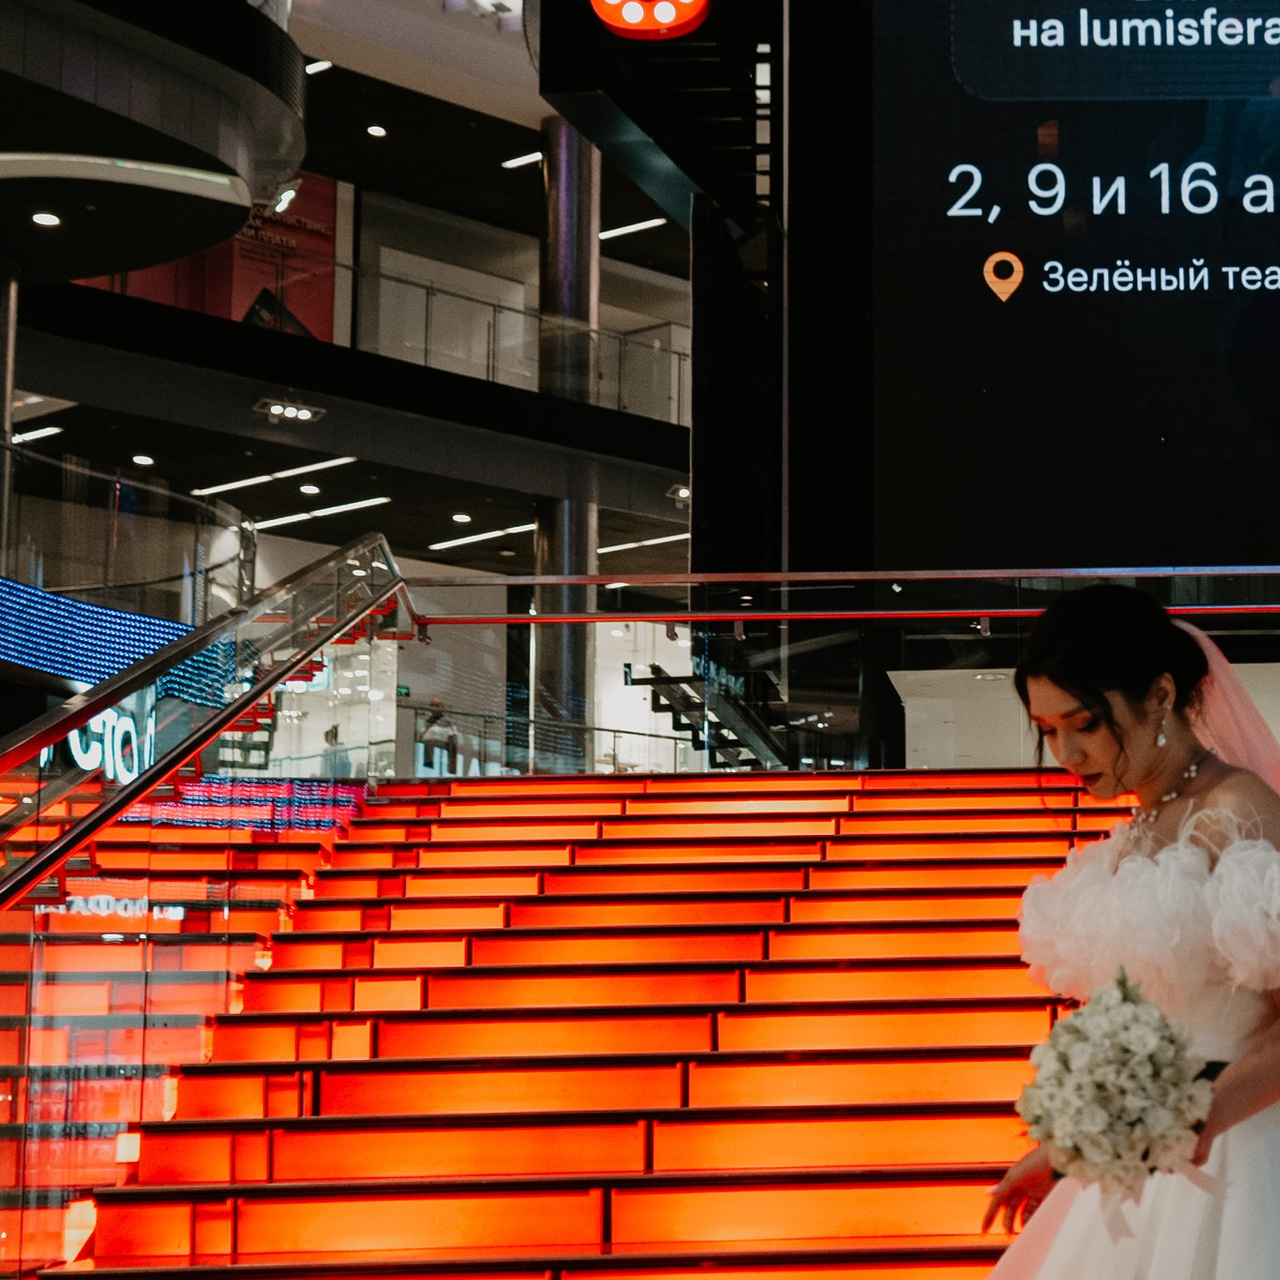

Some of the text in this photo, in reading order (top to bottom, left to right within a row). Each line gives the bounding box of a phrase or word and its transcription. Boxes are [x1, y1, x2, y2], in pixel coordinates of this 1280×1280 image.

[1012, 18, 1065, 48] на
[945, 162, 1002, 224] 2,
[1026, 161, 1067, 217] 9
[1091, 174, 1127, 216] и
[1148, 160, 1220, 216] 16
[1041, 257, 1210, 293] Зелёный
